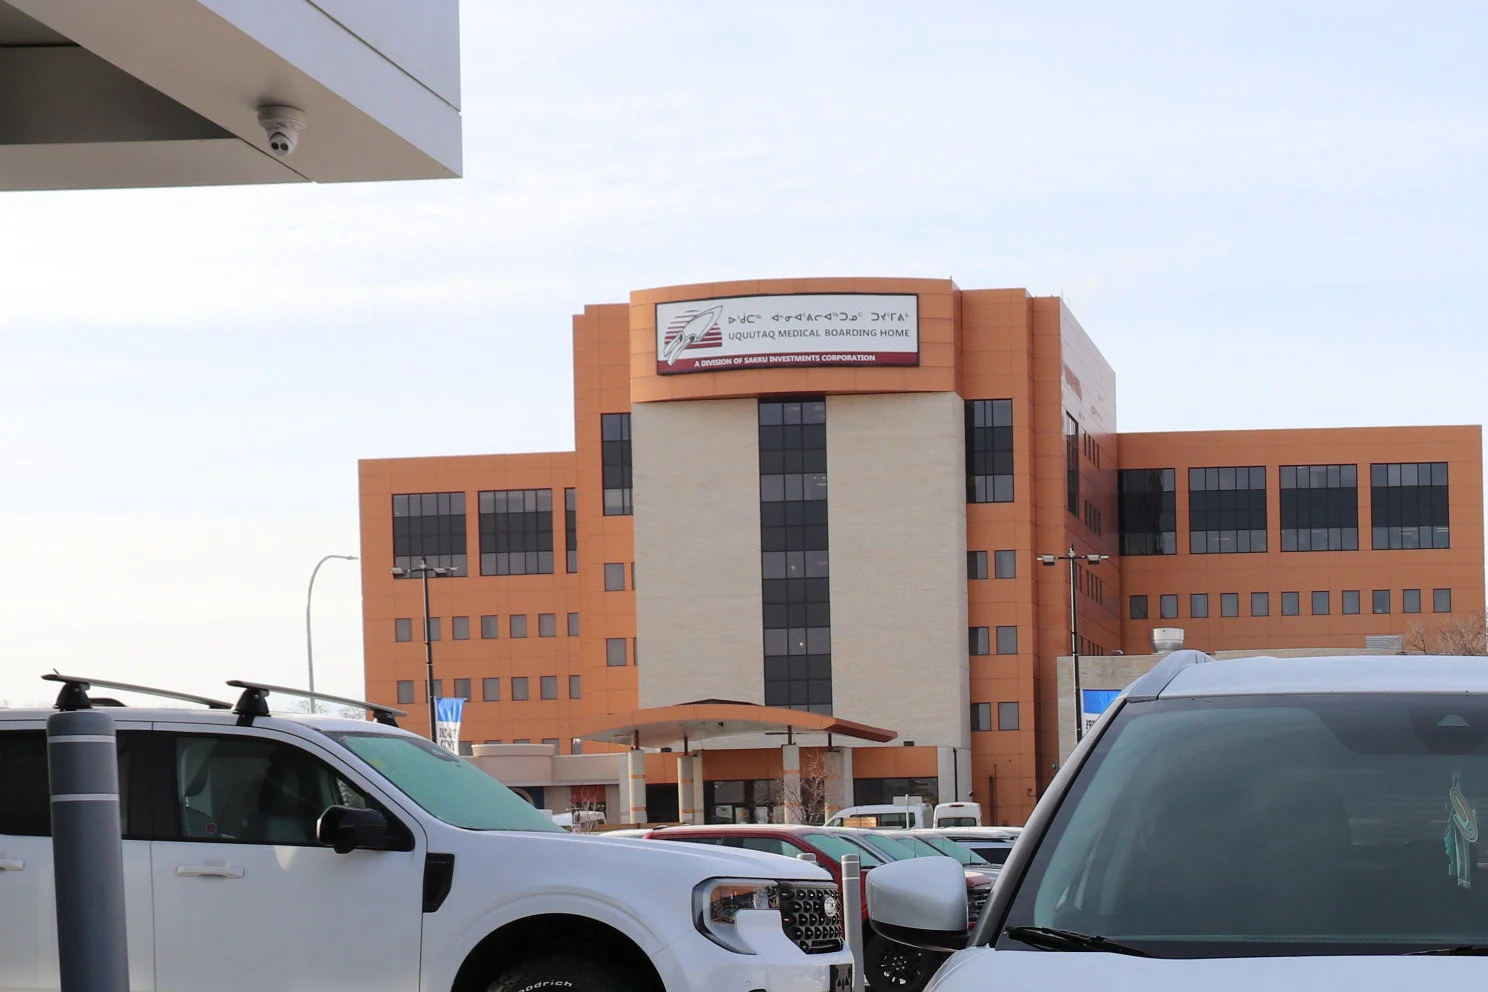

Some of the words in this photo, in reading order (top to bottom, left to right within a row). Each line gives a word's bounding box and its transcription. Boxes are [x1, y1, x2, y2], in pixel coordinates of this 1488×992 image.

[728, 330, 776, 341] UQUUTAQ
[778, 329, 820, 338] MEDICAL
[824, 328, 877, 337] BOARDING
[880, 329, 910, 337] HOME
[694, 360, 700, 368] A
[701, 358, 732, 367] DIVISION
[733, 357, 743, 365] OF
[744, 355, 768, 364] SAKKU
[769, 354, 820, 363] INVESTMENTS
[821, 354, 876, 362] CORPORATION
